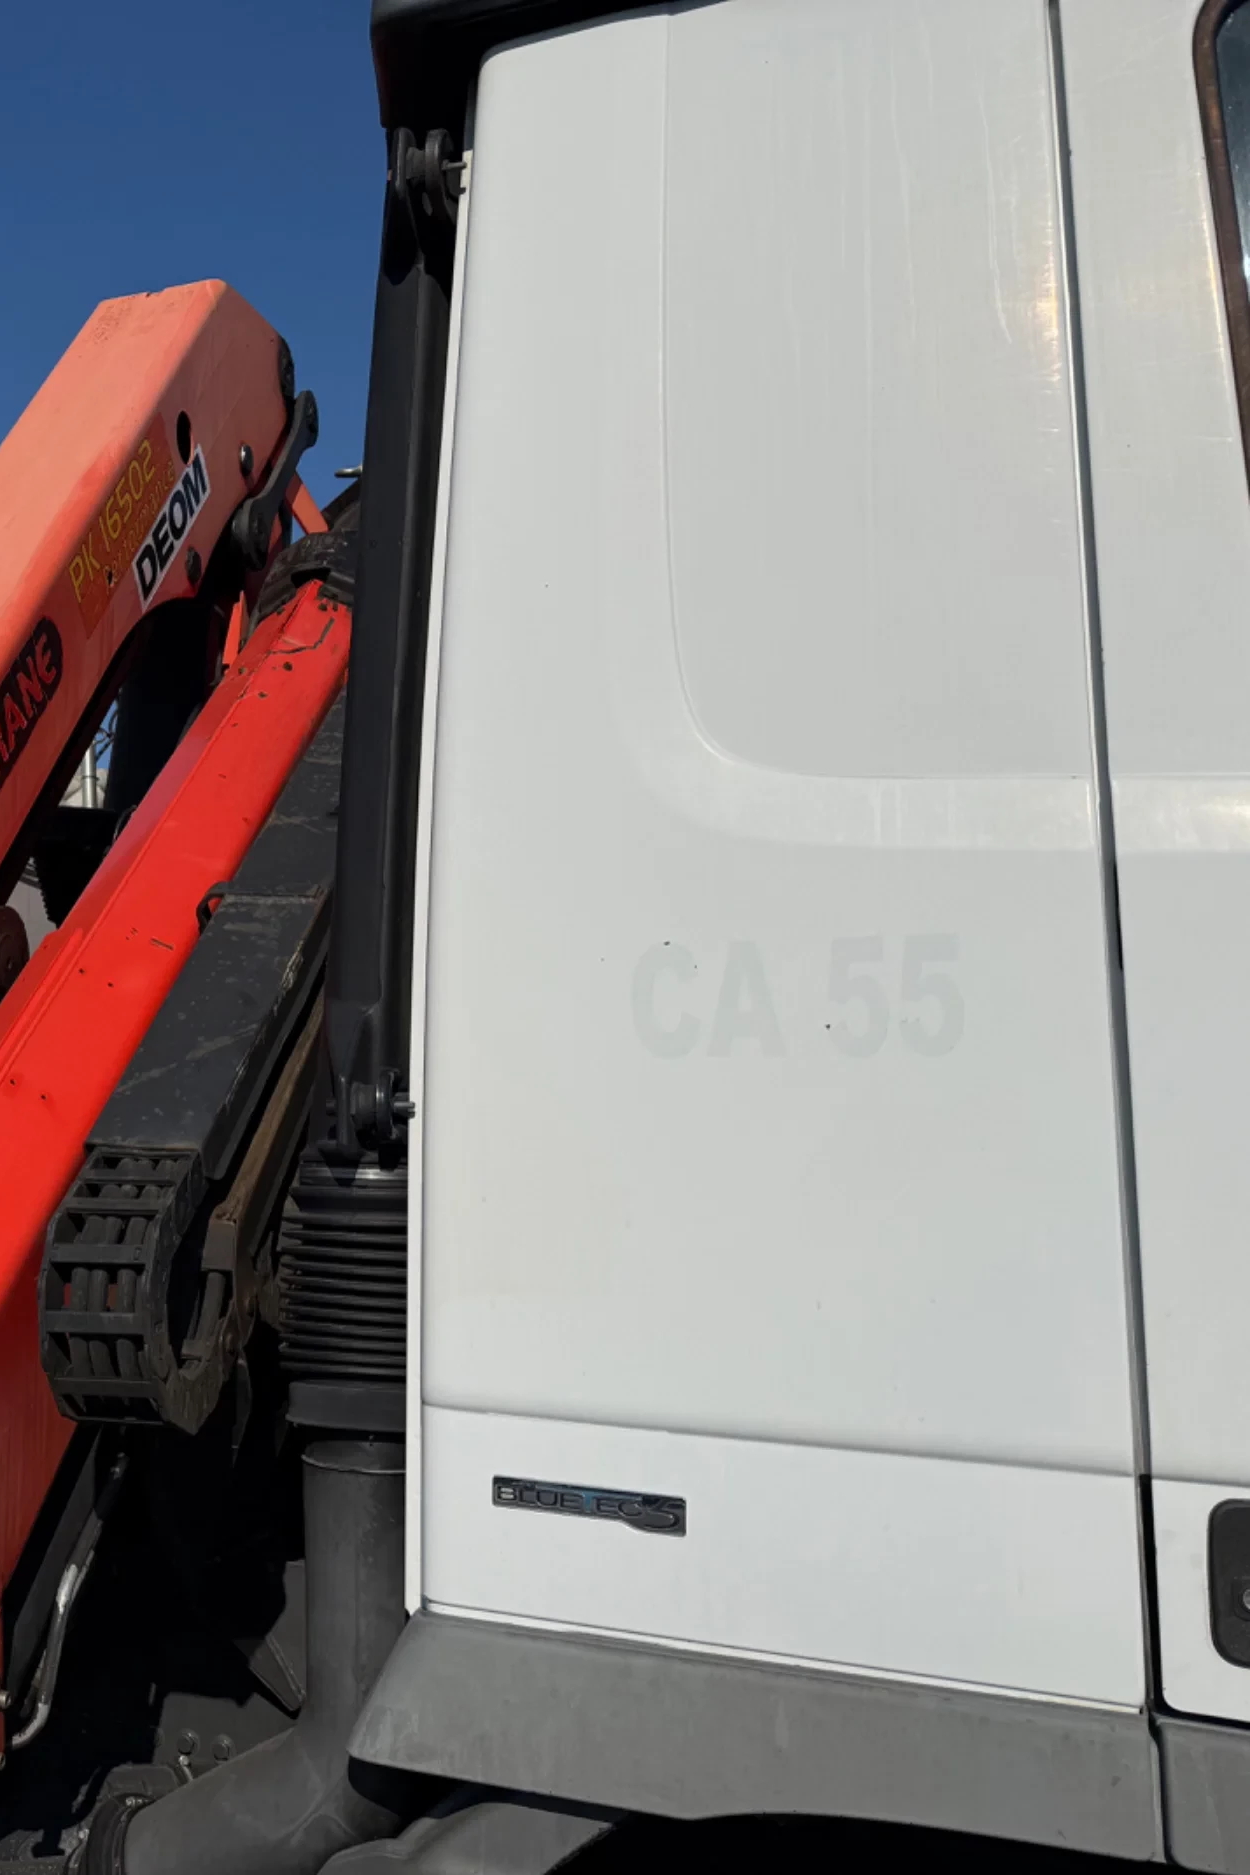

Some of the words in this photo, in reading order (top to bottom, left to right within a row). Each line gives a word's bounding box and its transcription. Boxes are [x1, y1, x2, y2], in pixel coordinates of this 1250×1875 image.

[69, 531, 100, 603] PK
[99, 439, 156, 552] 16502
[136, 453, 208, 601] DEOM
[630, 939, 788, 1060] CA
[826, 931, 966, 1060] 55
